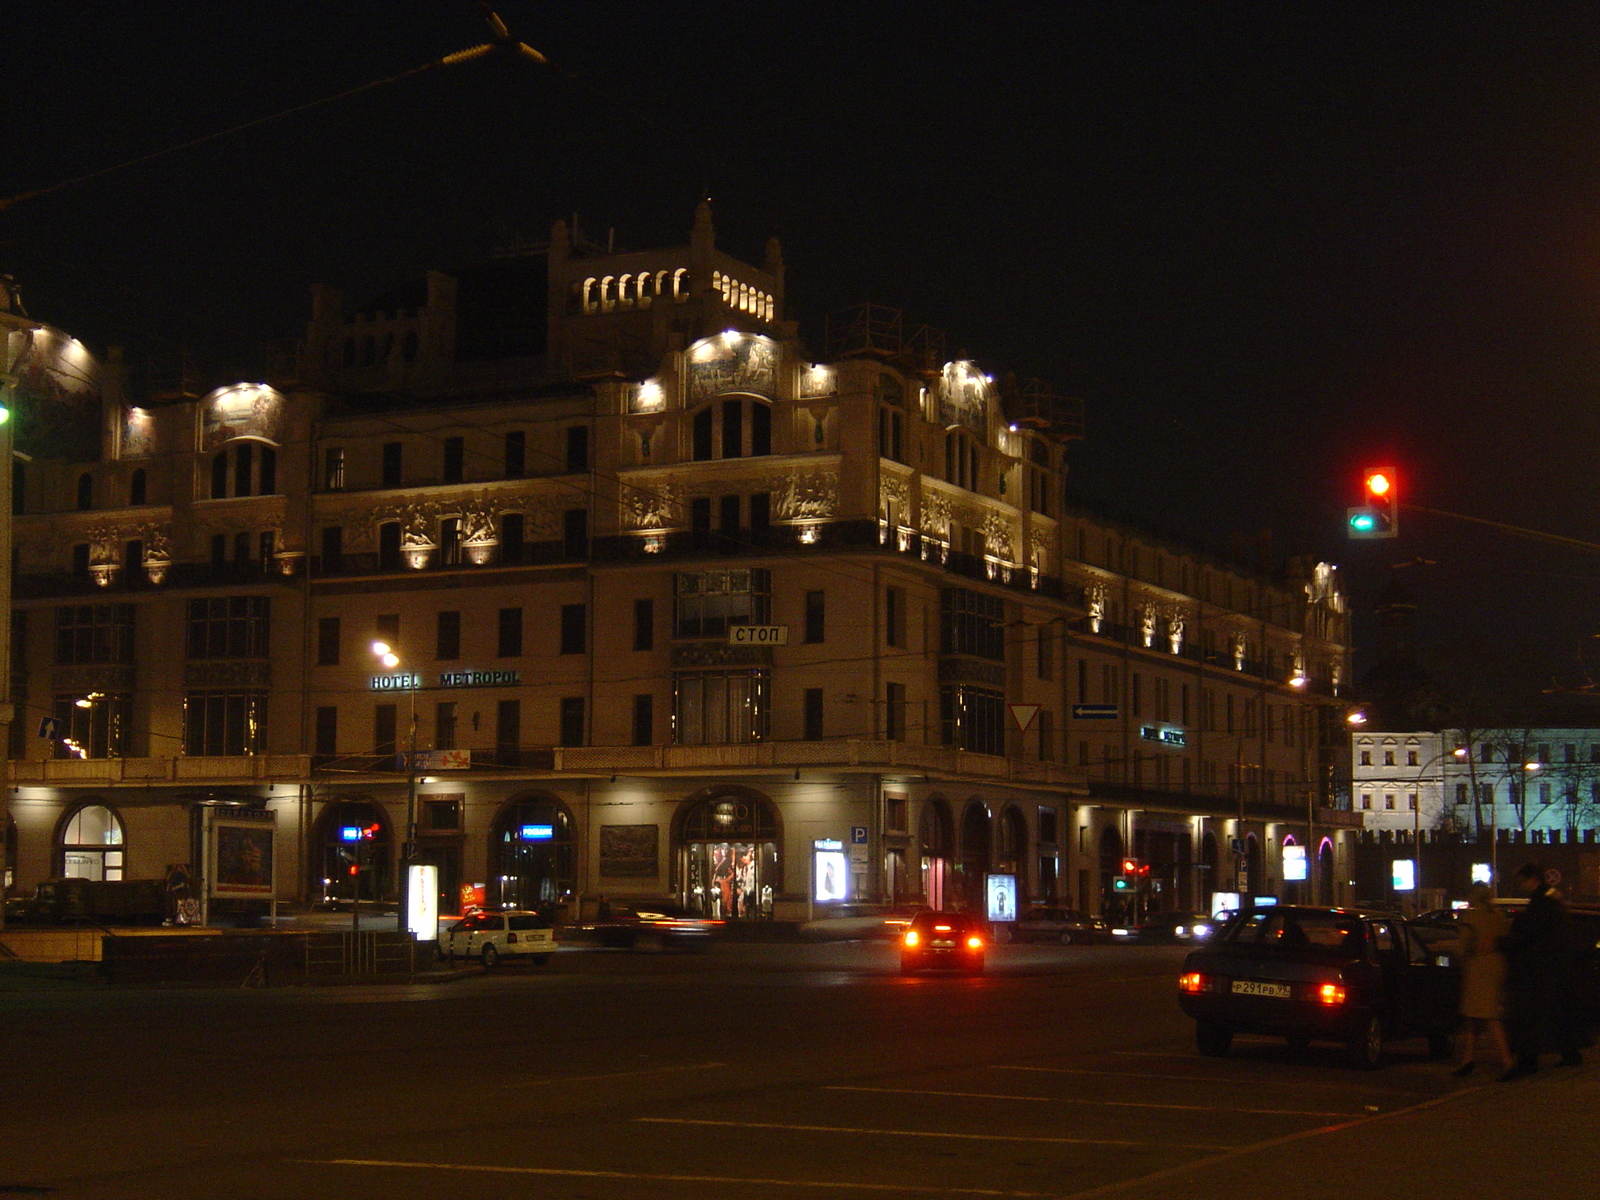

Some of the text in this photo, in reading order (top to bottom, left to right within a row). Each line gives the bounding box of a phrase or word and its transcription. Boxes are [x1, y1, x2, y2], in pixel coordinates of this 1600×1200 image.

[736, 628, 779, 642] СТОП
[371, 671, 520, 689] HOTEL METROPOL
[855, 828, 865, 842] P
